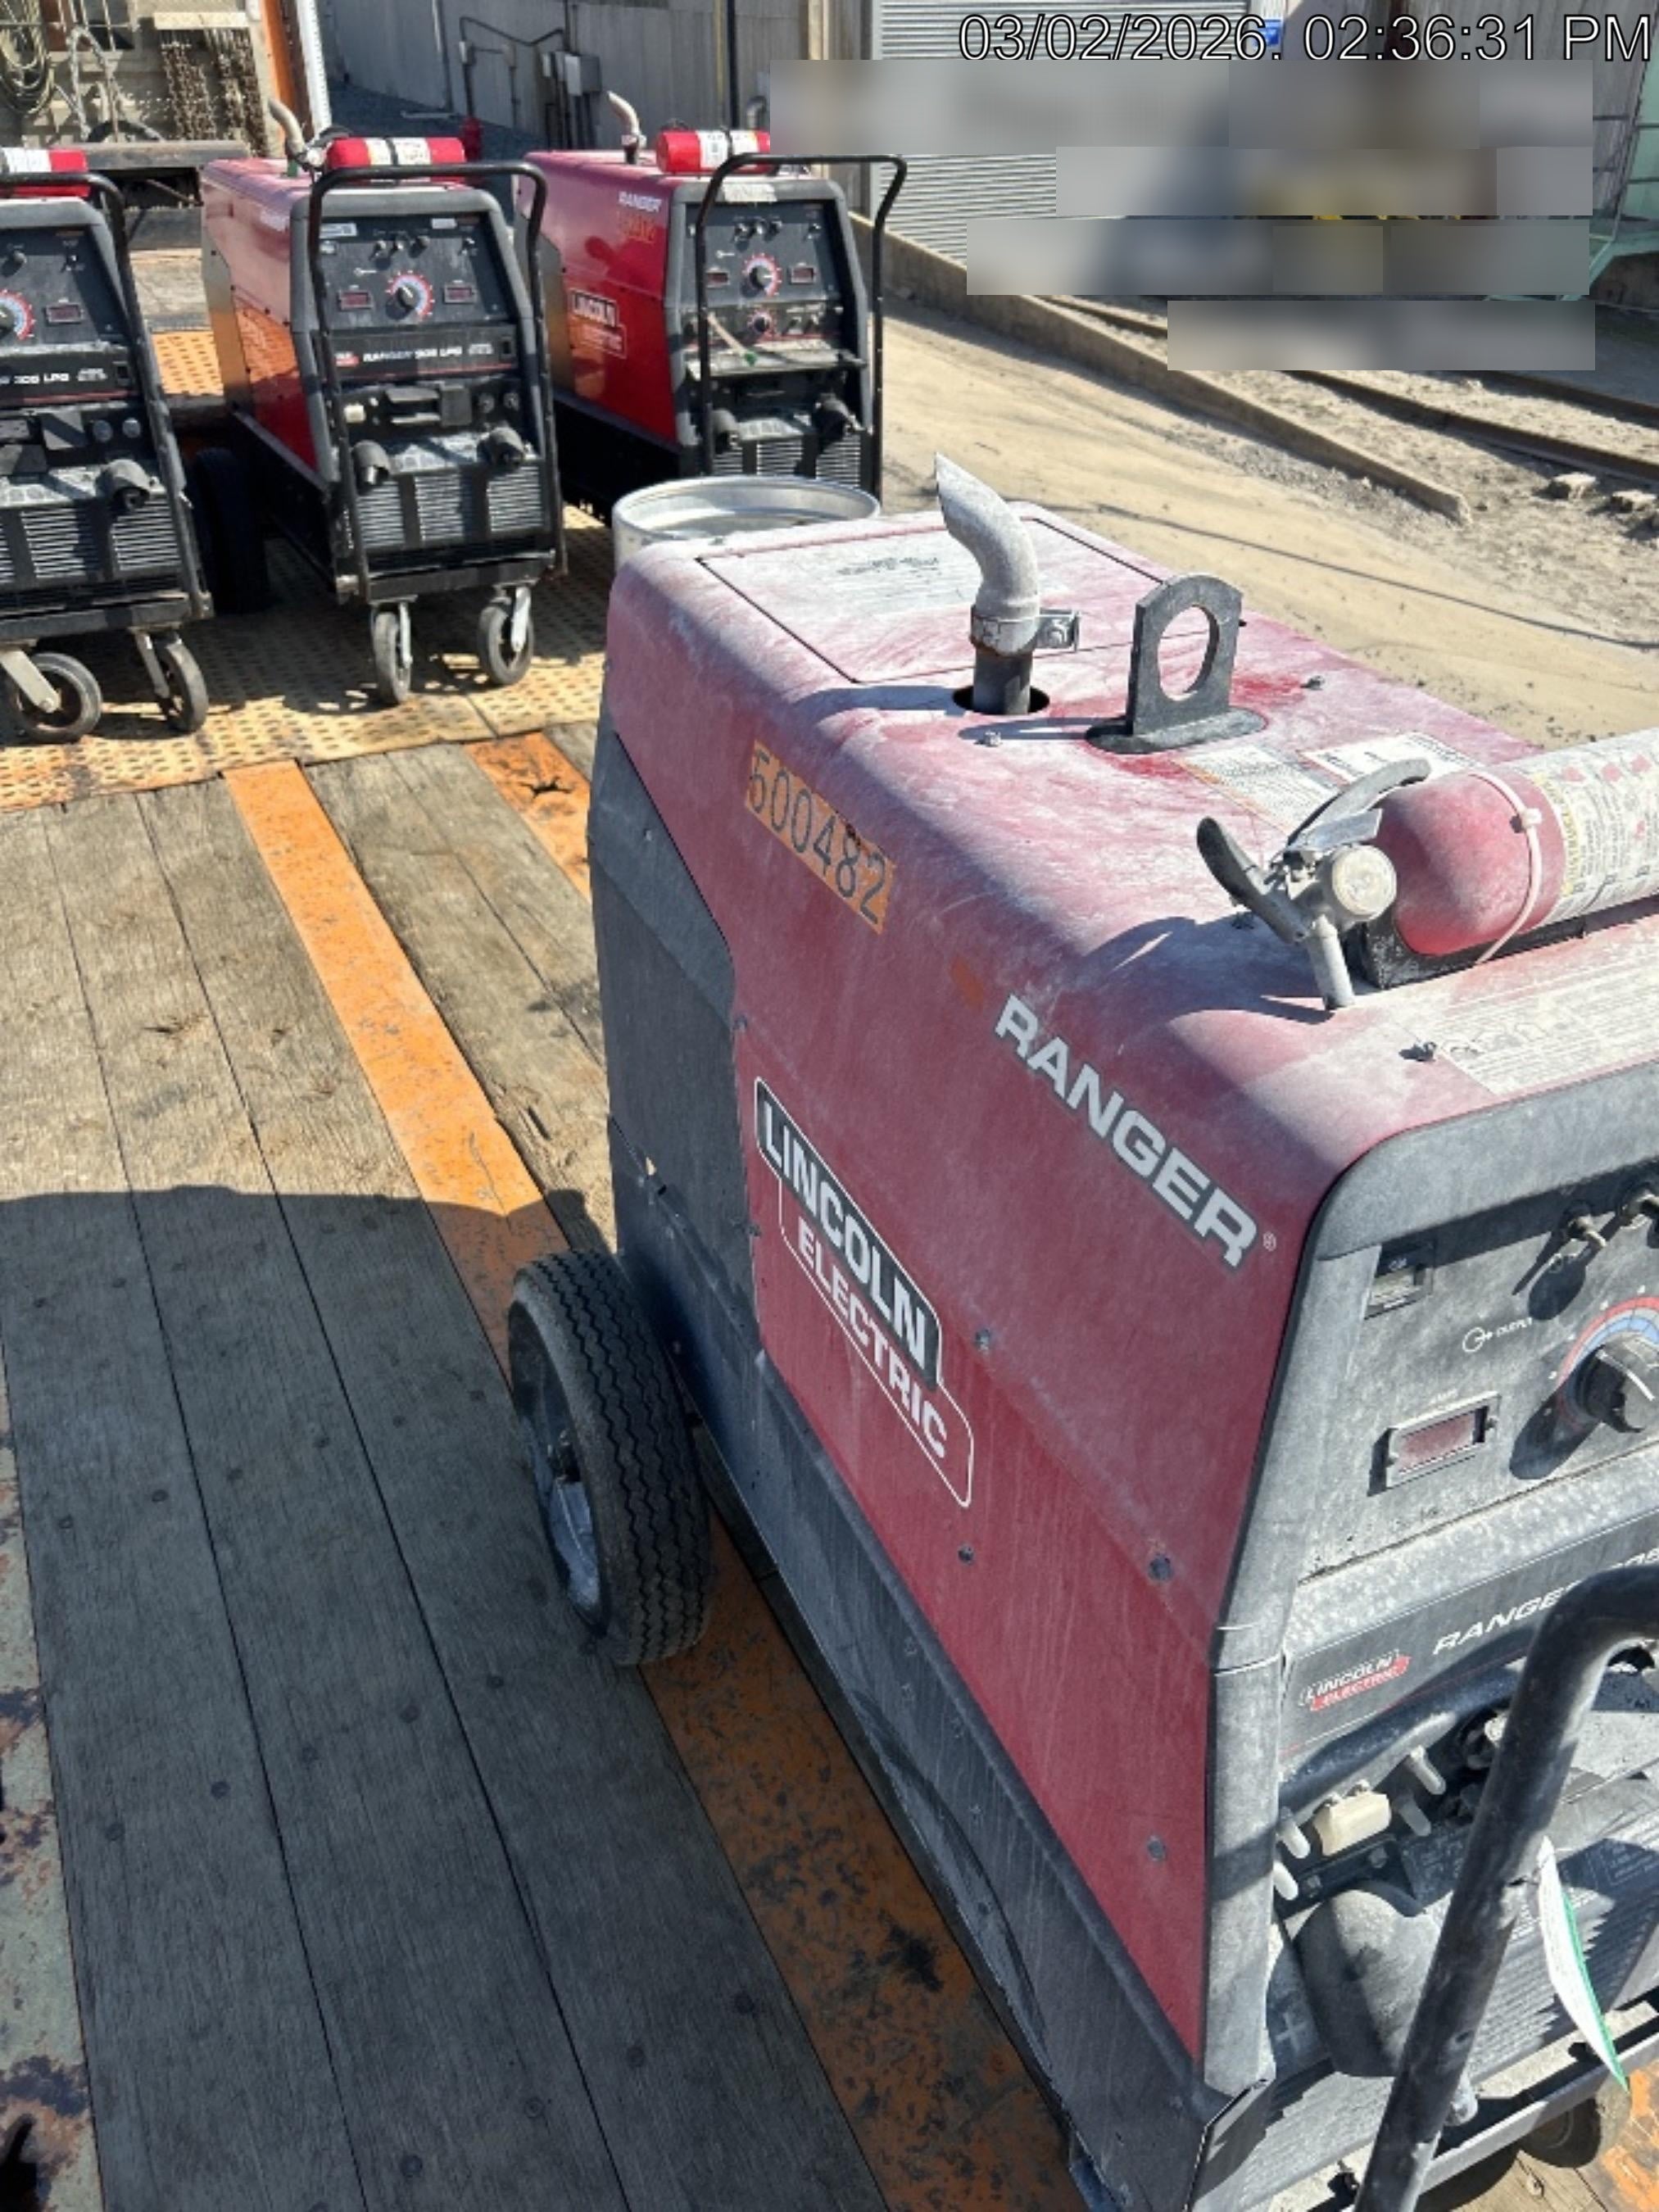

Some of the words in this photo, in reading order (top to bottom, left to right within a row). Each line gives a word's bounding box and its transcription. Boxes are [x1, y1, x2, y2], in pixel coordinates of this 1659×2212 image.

[751, 749, 886, 925] 500482
[764, 1100, 926, 1370] LINCOLN
[994, 994, 1258, 1267] RANGER
[797, 1215, 947, 1459] ELECTRIC
[1433, 1580, 1581, 1655] RANGE
